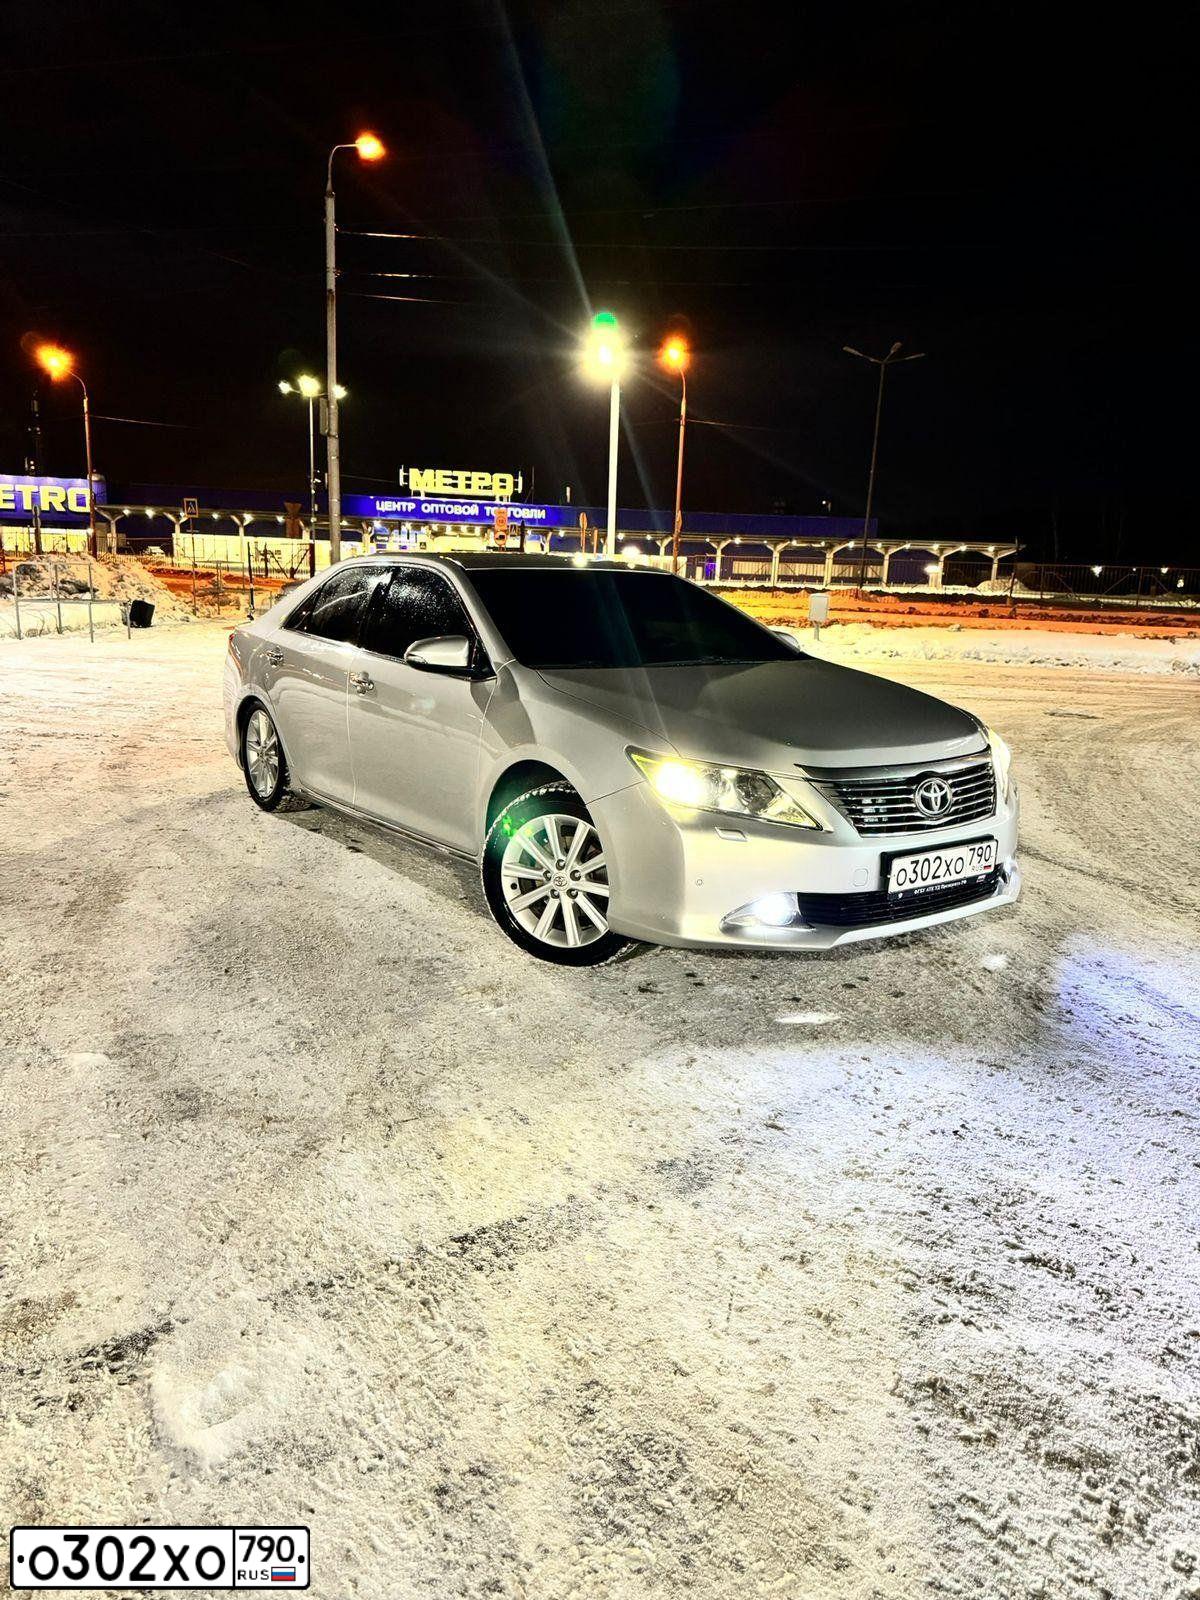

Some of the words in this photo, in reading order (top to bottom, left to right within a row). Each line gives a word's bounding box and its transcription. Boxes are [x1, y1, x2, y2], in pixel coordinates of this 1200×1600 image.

[376, 501, 415, 513] ЦЕНТР
[421, 503, 479, 516] ОПТОВОЙ
[484, 506, 546, 519] ТОГОВЛИ
[969, 845, 991, 866] 790
